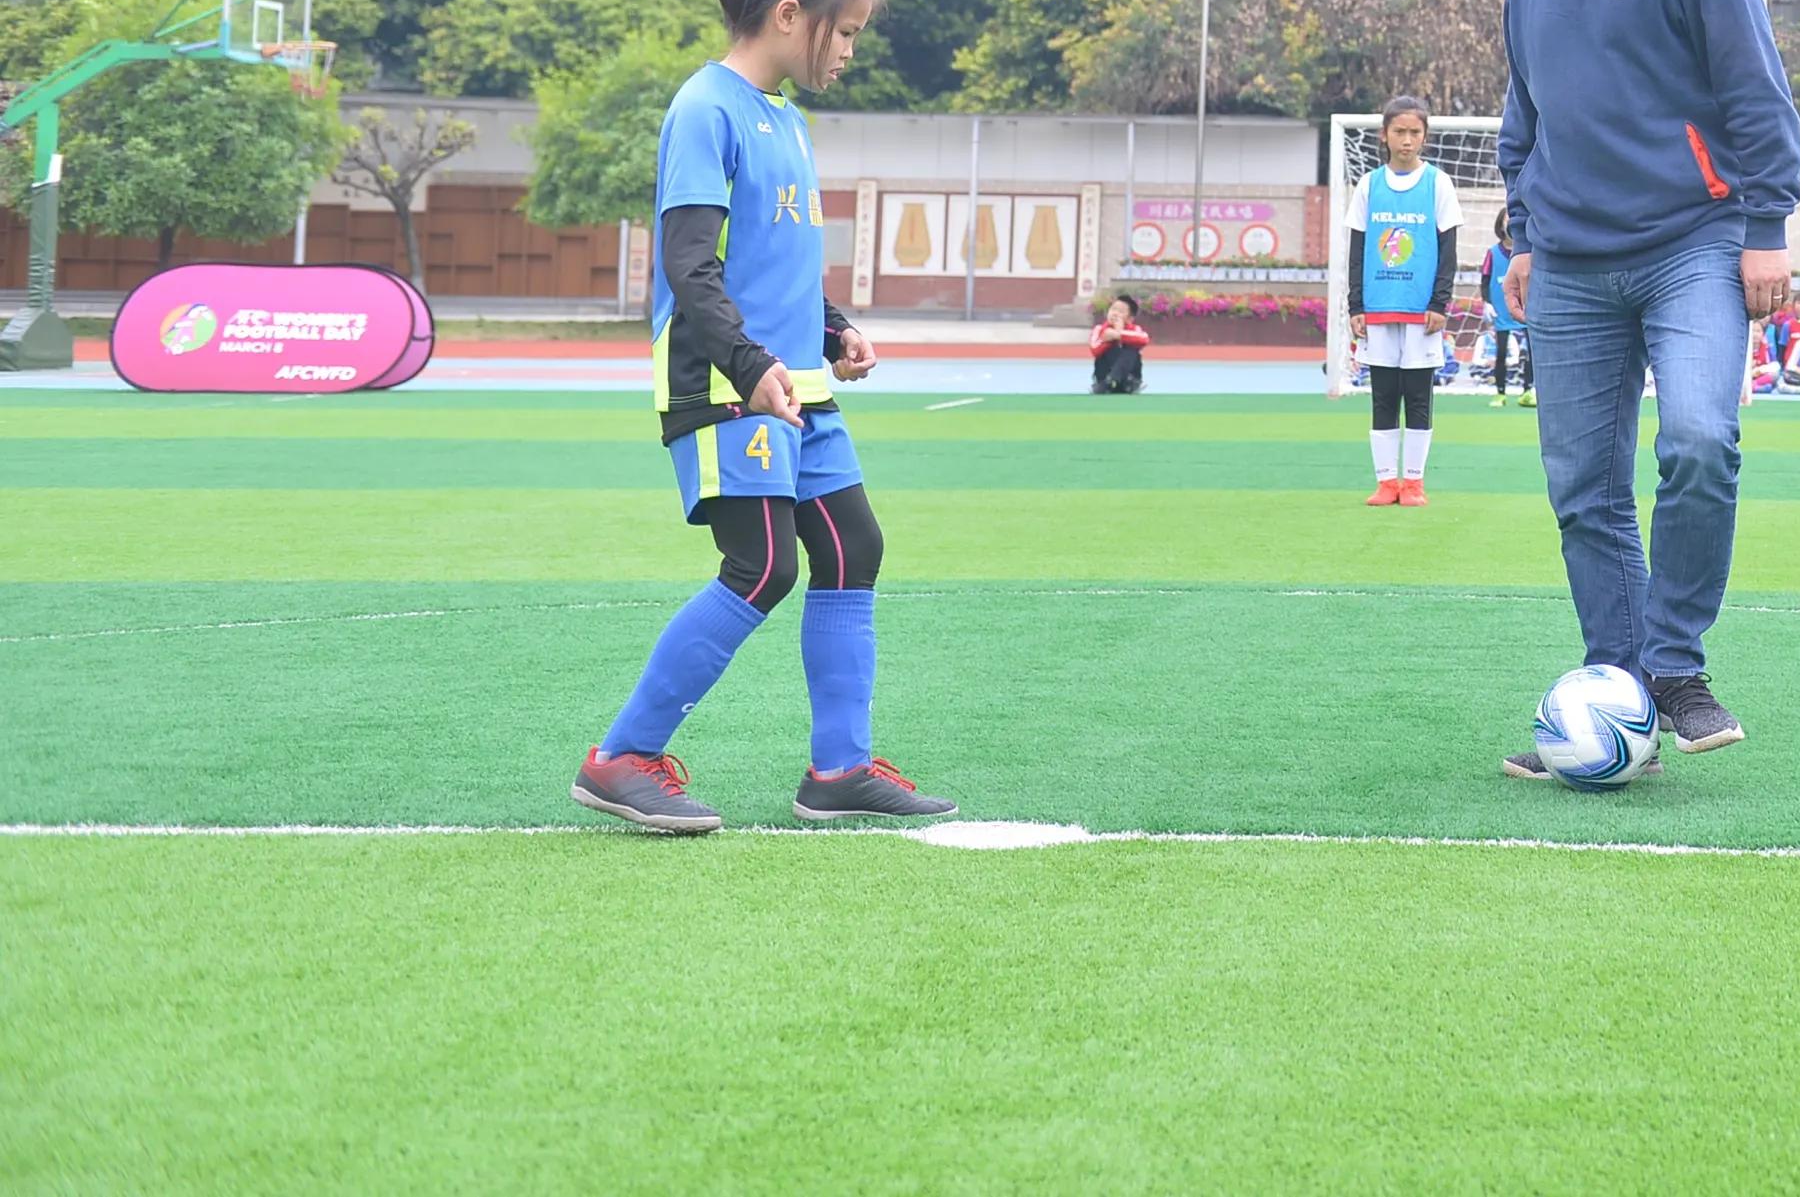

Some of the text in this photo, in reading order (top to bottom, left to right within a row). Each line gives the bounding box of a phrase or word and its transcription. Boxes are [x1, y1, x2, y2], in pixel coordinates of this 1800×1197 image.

[1371, 211, 1416, 224] KELME
[223, 324, 367, 341] FOOTBALL DAY
[219, 342, 272, 353] MARCH
[274, 365, 357, 381] AFCWFD
[745, 423, 772, 471] 4
